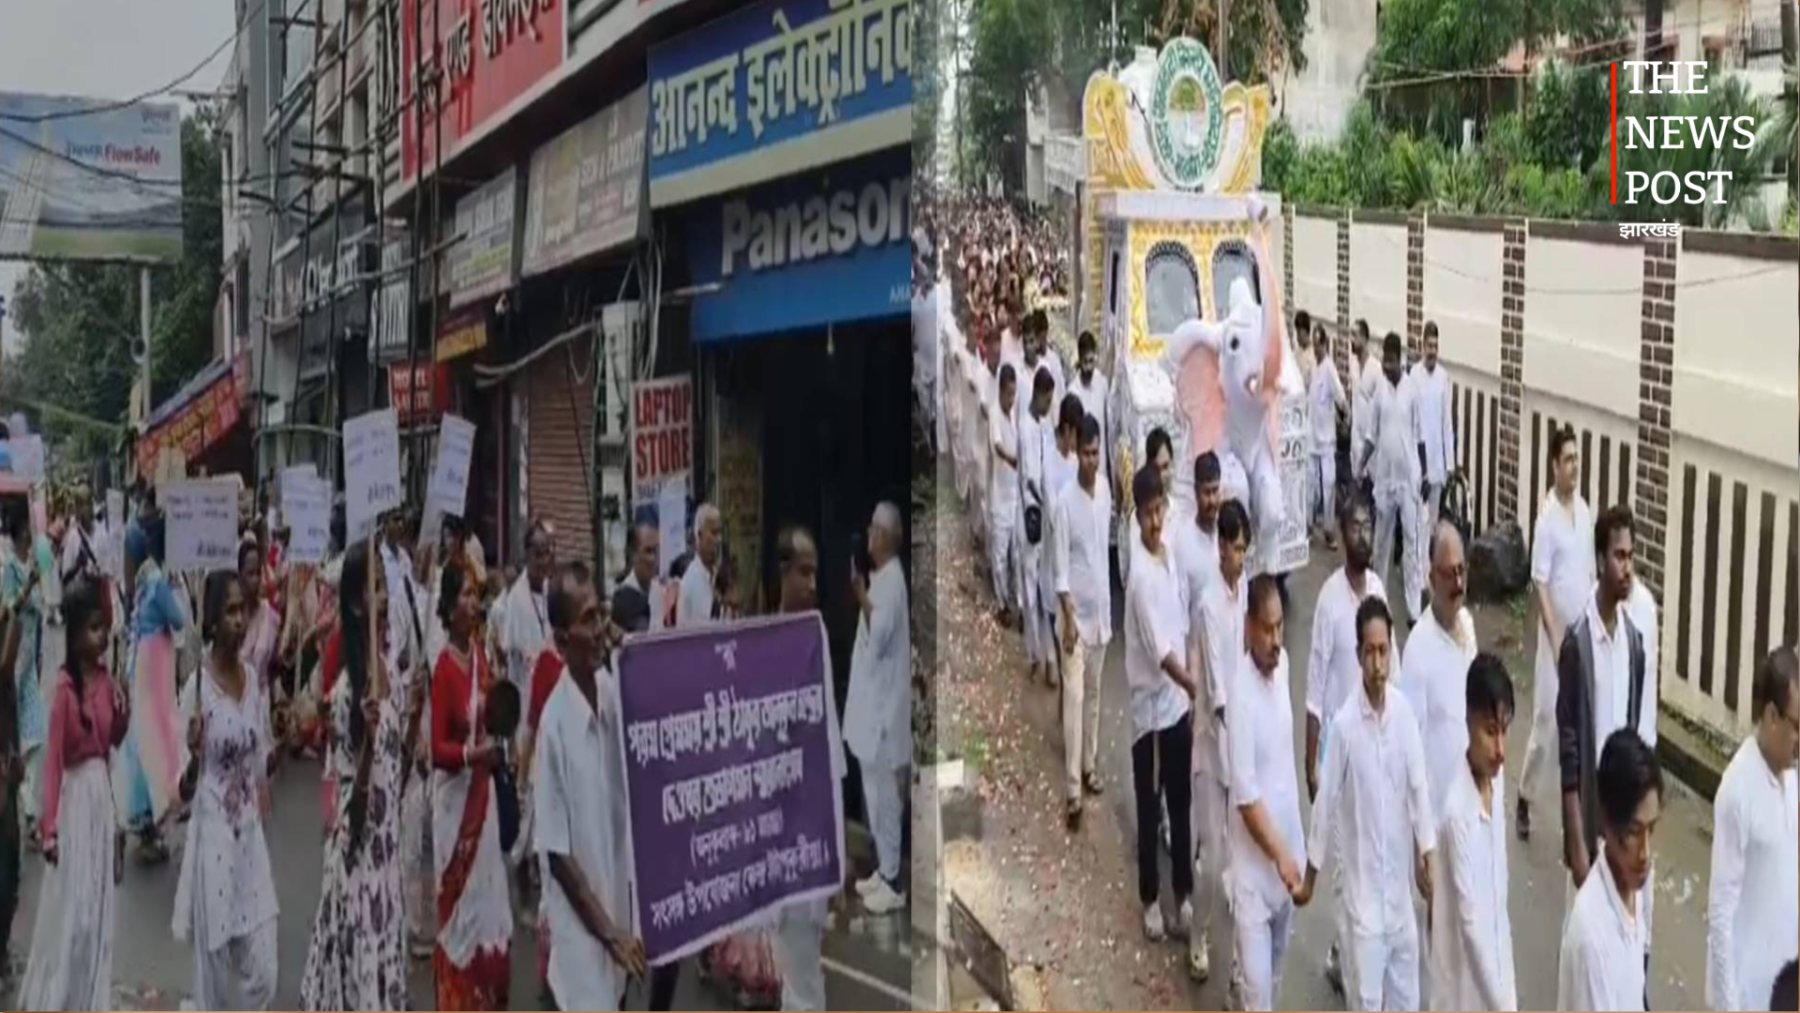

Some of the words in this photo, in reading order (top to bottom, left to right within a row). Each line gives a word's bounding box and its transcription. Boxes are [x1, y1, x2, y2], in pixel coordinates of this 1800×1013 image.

[652, 53, 739, 155] आनन्द
[635, 383, 691, 428] LAPTOP
[636, 426, 691, 478] STORE
